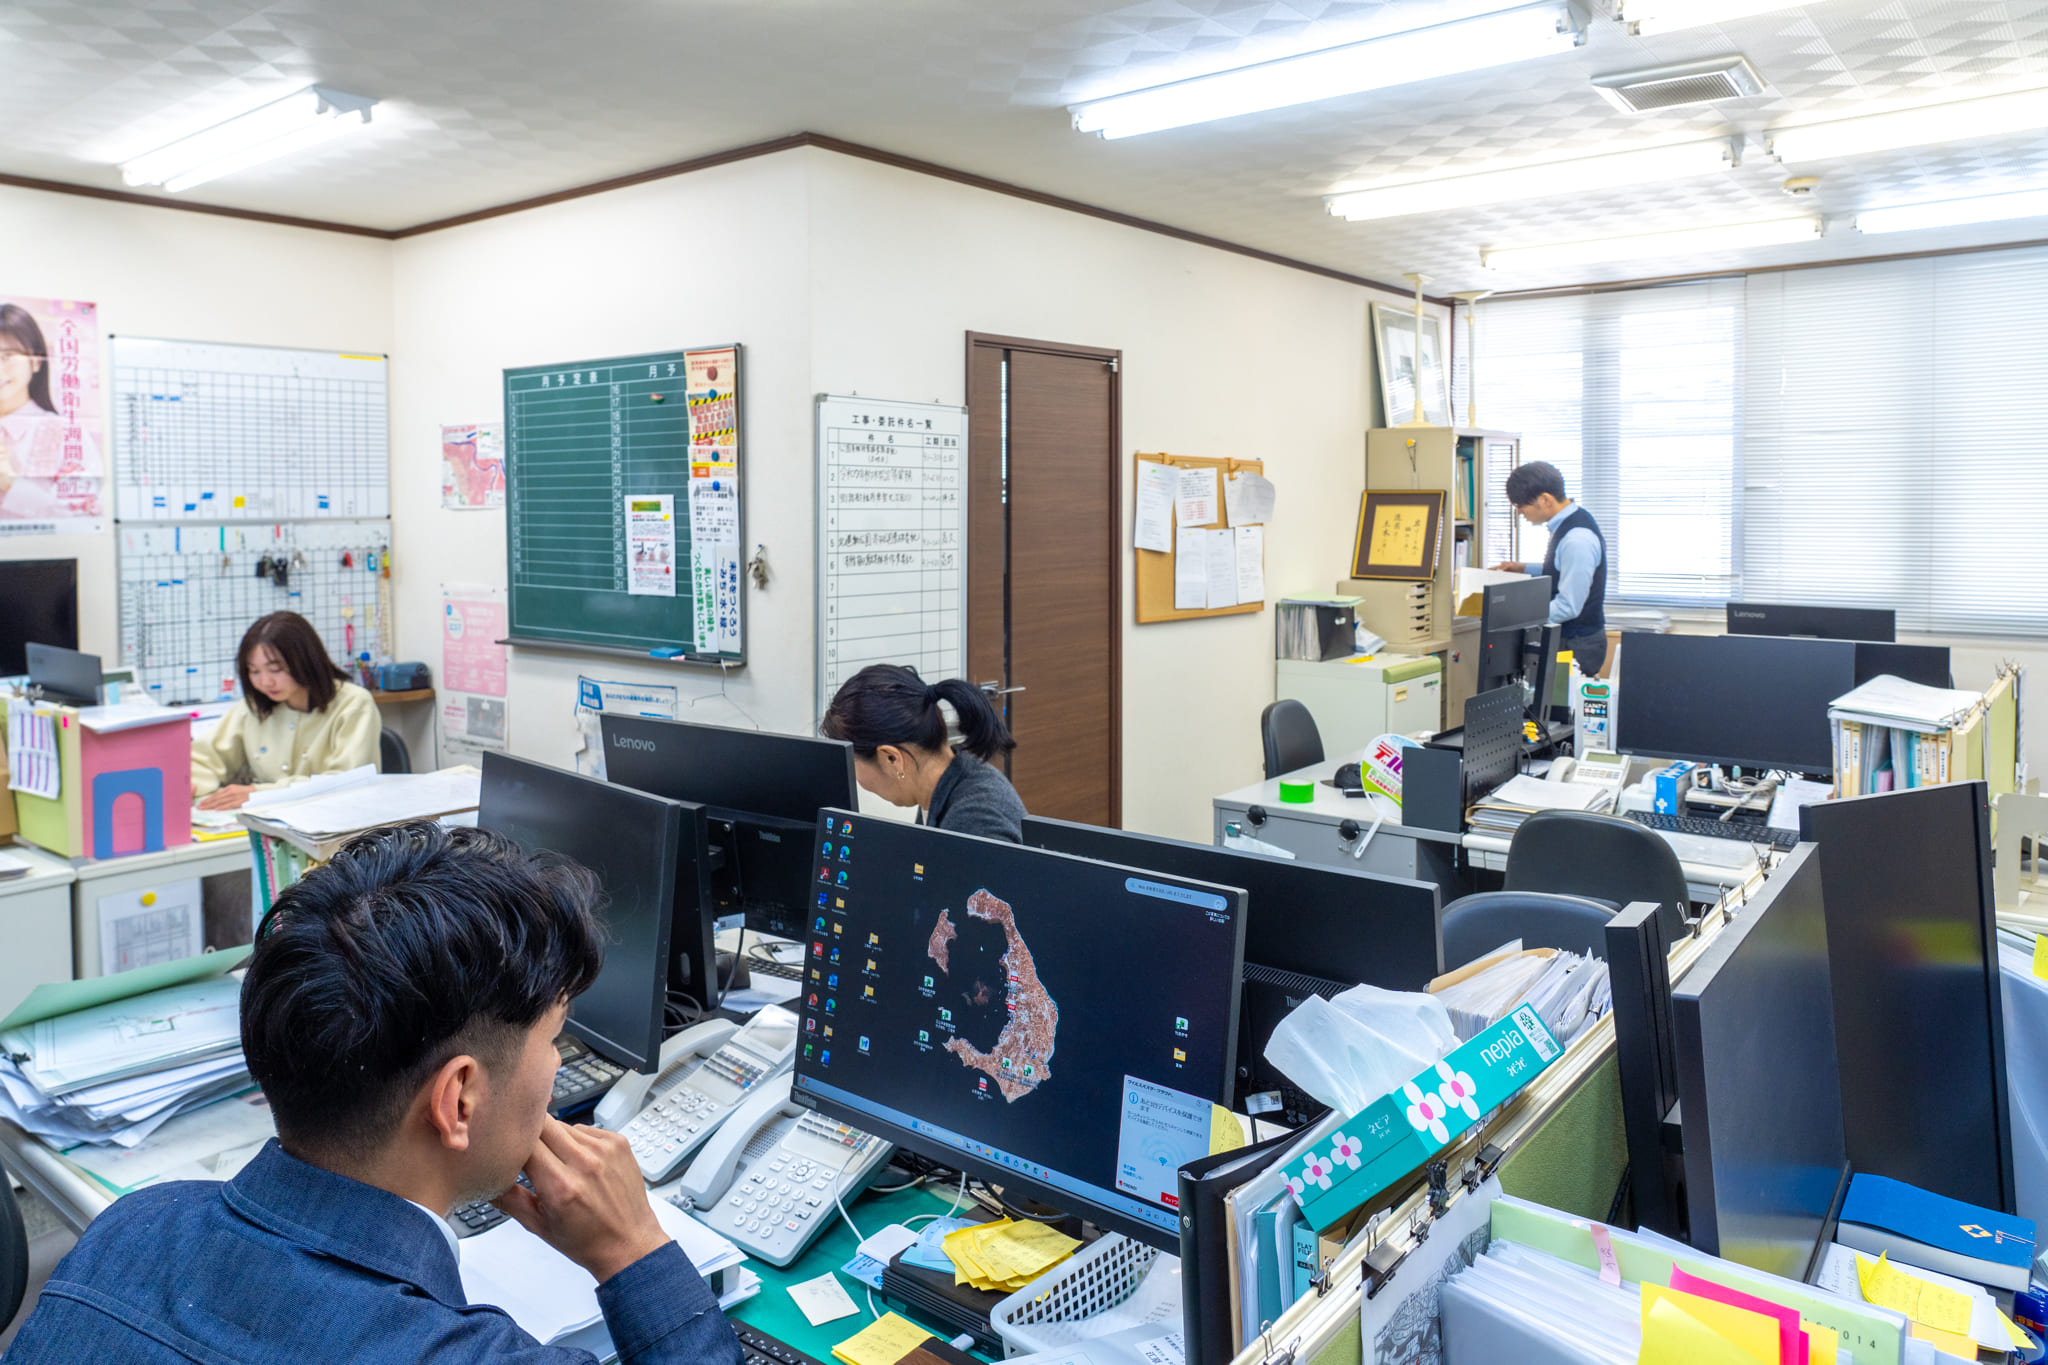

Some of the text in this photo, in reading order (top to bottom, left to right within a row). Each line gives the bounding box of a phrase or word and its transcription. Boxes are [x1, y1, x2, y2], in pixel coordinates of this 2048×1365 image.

[59, 319, 83, 460] 全国労働衛生週間
[851, 414, 933, 430] 工事・委託件名一覧
[1734, 610, 1766, 619] Lenovo
[613, 733, 656, 752] Lenovo
[1480, 1030, 1524, 1067] nepia
[1367, 1114, 1390, 1135] ネピア
[1297, 1241, 1313, 1251] FLAT
